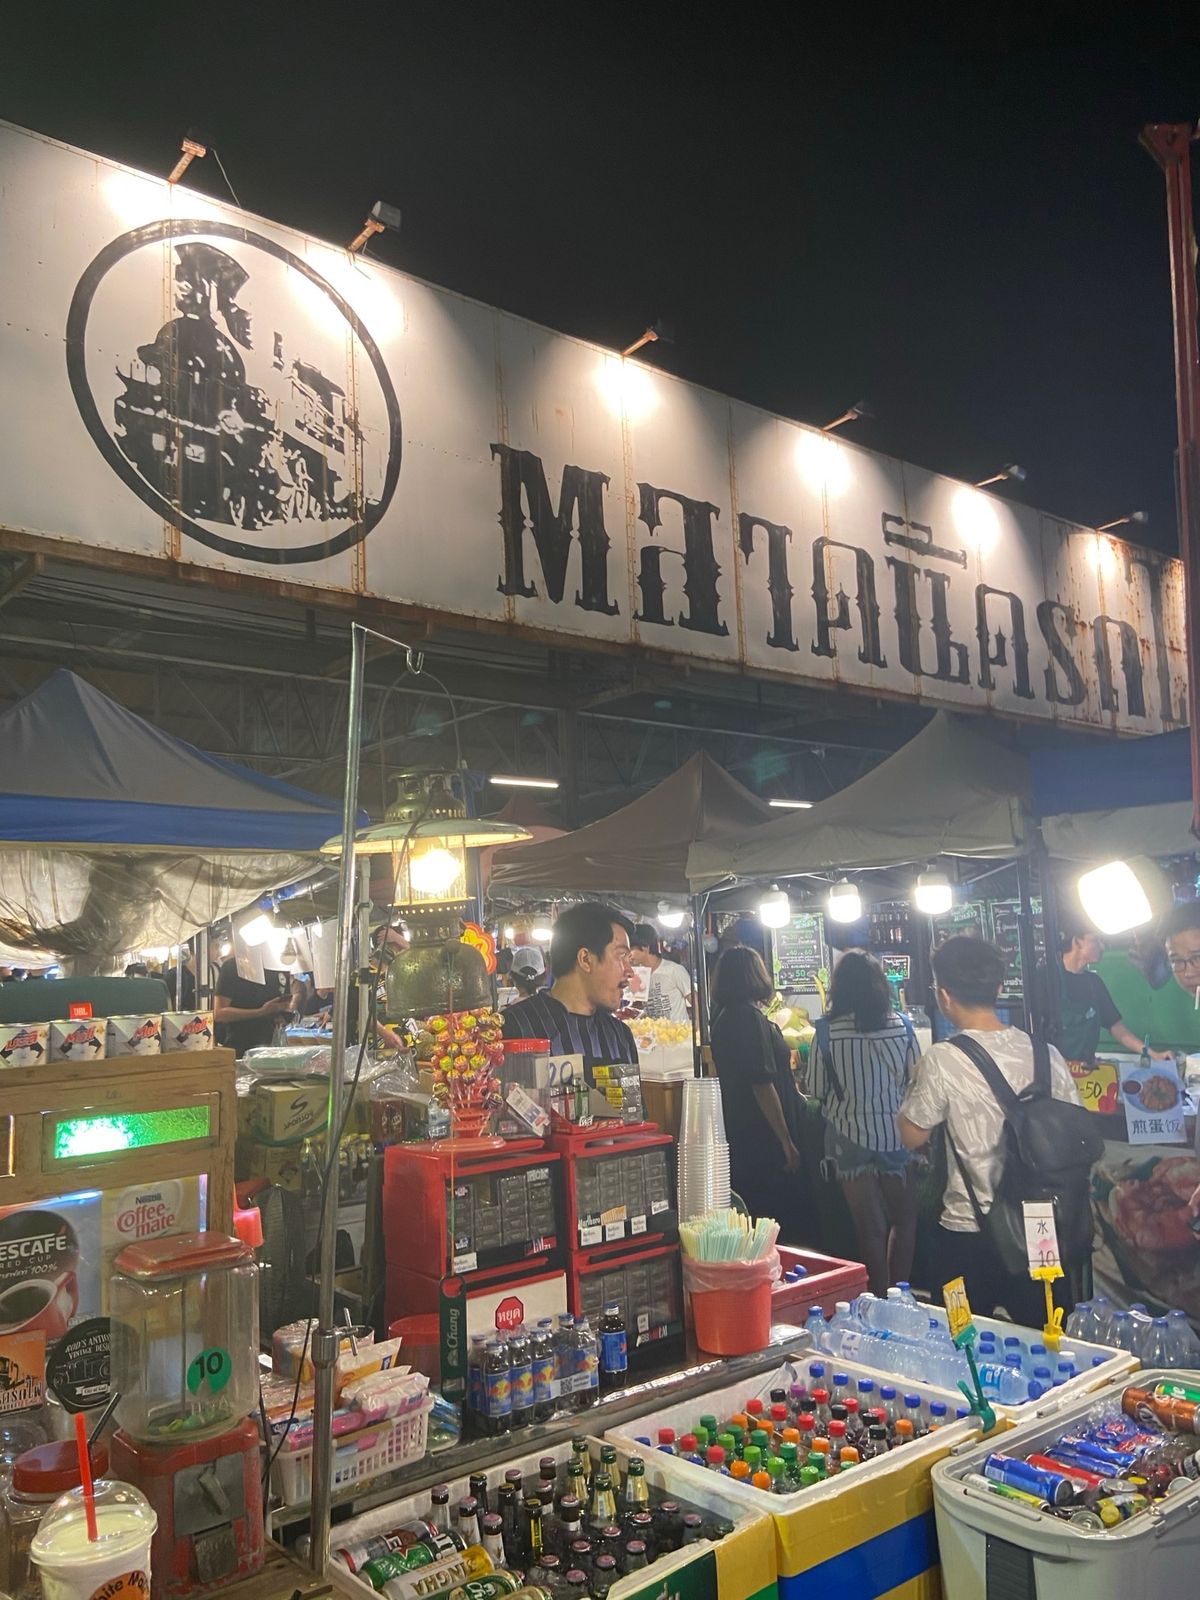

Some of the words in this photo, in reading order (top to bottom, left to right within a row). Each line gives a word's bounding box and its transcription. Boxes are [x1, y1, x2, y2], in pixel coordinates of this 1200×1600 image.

[489, 443, 1187, 727] ตลาดนัดรถไ
[1132, 1118, 1180, 1135] 煎蛋饭
[135, 1213, 176, 1238] mate
[1037, 1219, 1049, 1235] 水
[29, 1255, 52, 1264] CUP
[1038, 1250, 1056, 1268] 10
[31, 1262, 58, 1275] 100%
[497, 1307, 521, 1326] หยุด
[446, 1308, 460, 1348] Chang
[195, 1351, 223, 1379] 10
